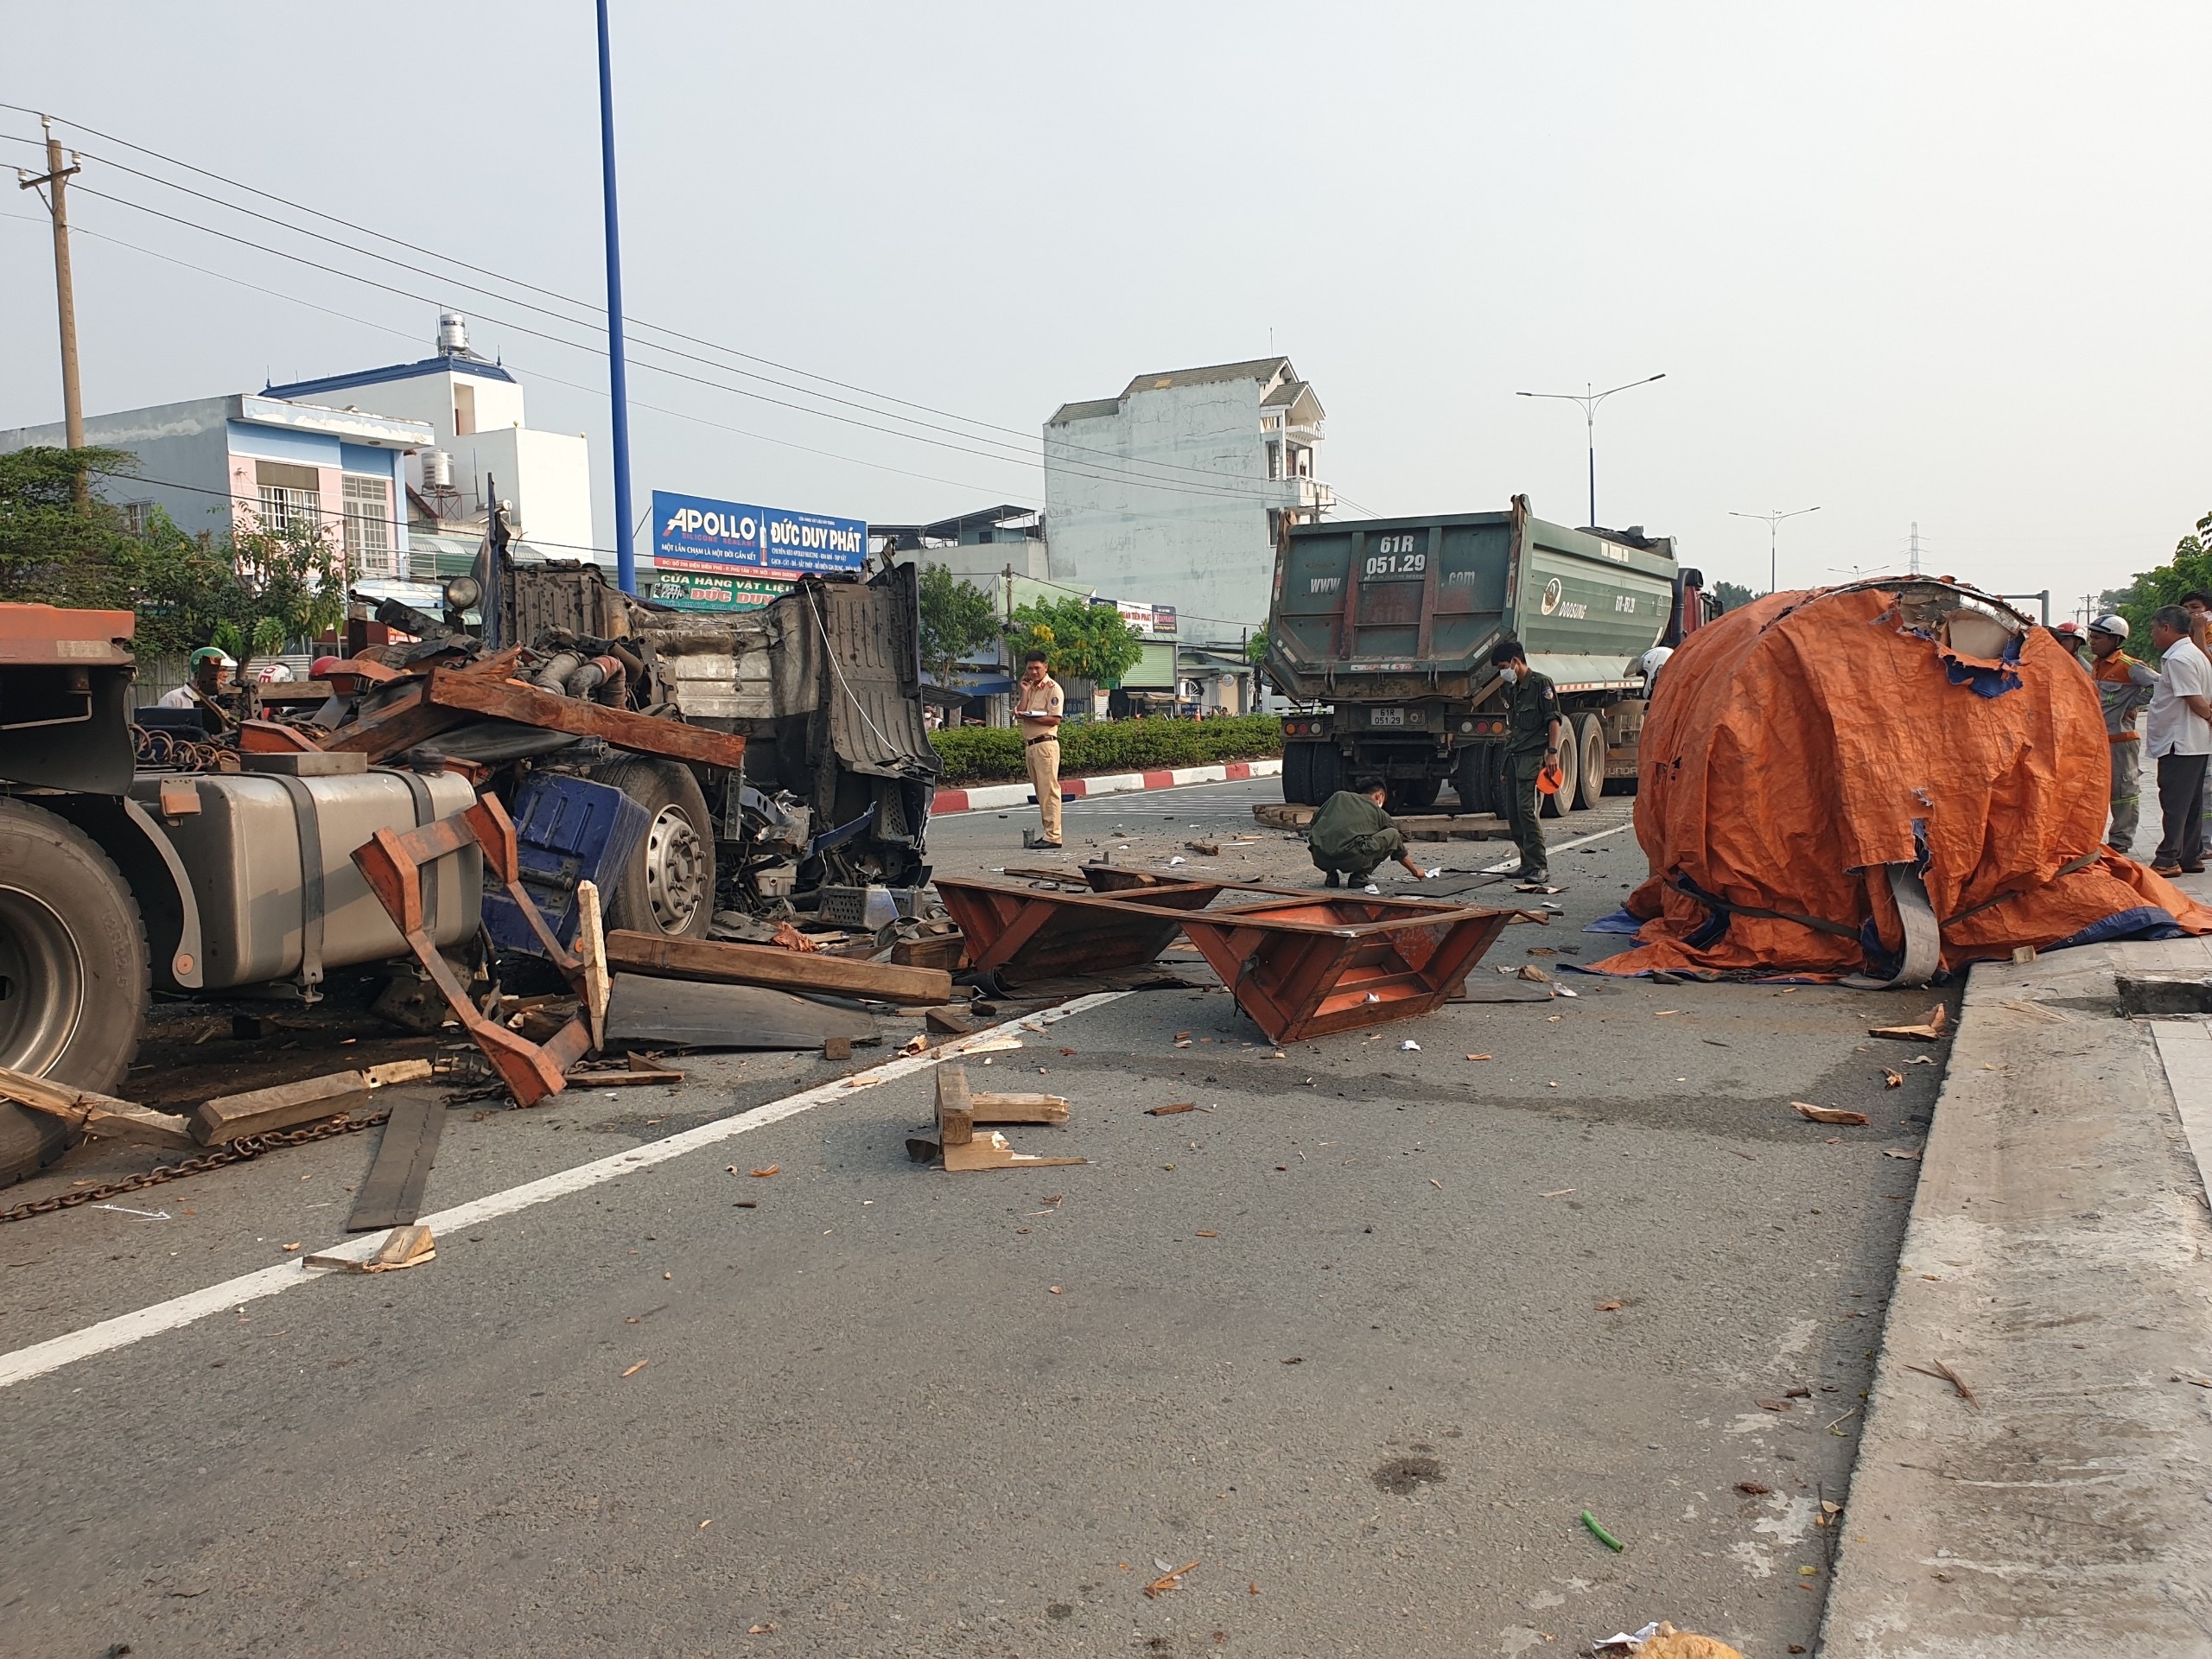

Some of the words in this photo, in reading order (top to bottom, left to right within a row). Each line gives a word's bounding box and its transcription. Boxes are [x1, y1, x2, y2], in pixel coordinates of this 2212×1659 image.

[663, 508, 756, 541] APOLLO
[682, 532, 719, 543] SILICONE
[722, 537, 756, 548] SEALANT
[771, 518, 799, 546] ĐỨC
[802, 526, 828, 550] DUY
[830, 526, 861, 553] PHÁT
[1380, 535, 1414, 553] 61R
[661, 543, 674, 553] MỘT
[687, 546, 703, 556] CHẠM
[1366, 554, 1426, 575] 051.29
[695, 576, 733, 588] HÀNG
[736, 581, 761, 590] VẬT
[690, 587, 733, 602] ĐỨC
[736, 592, 775, 606] DUY
[1559, 601, 1586, 619] DOOSUNG
